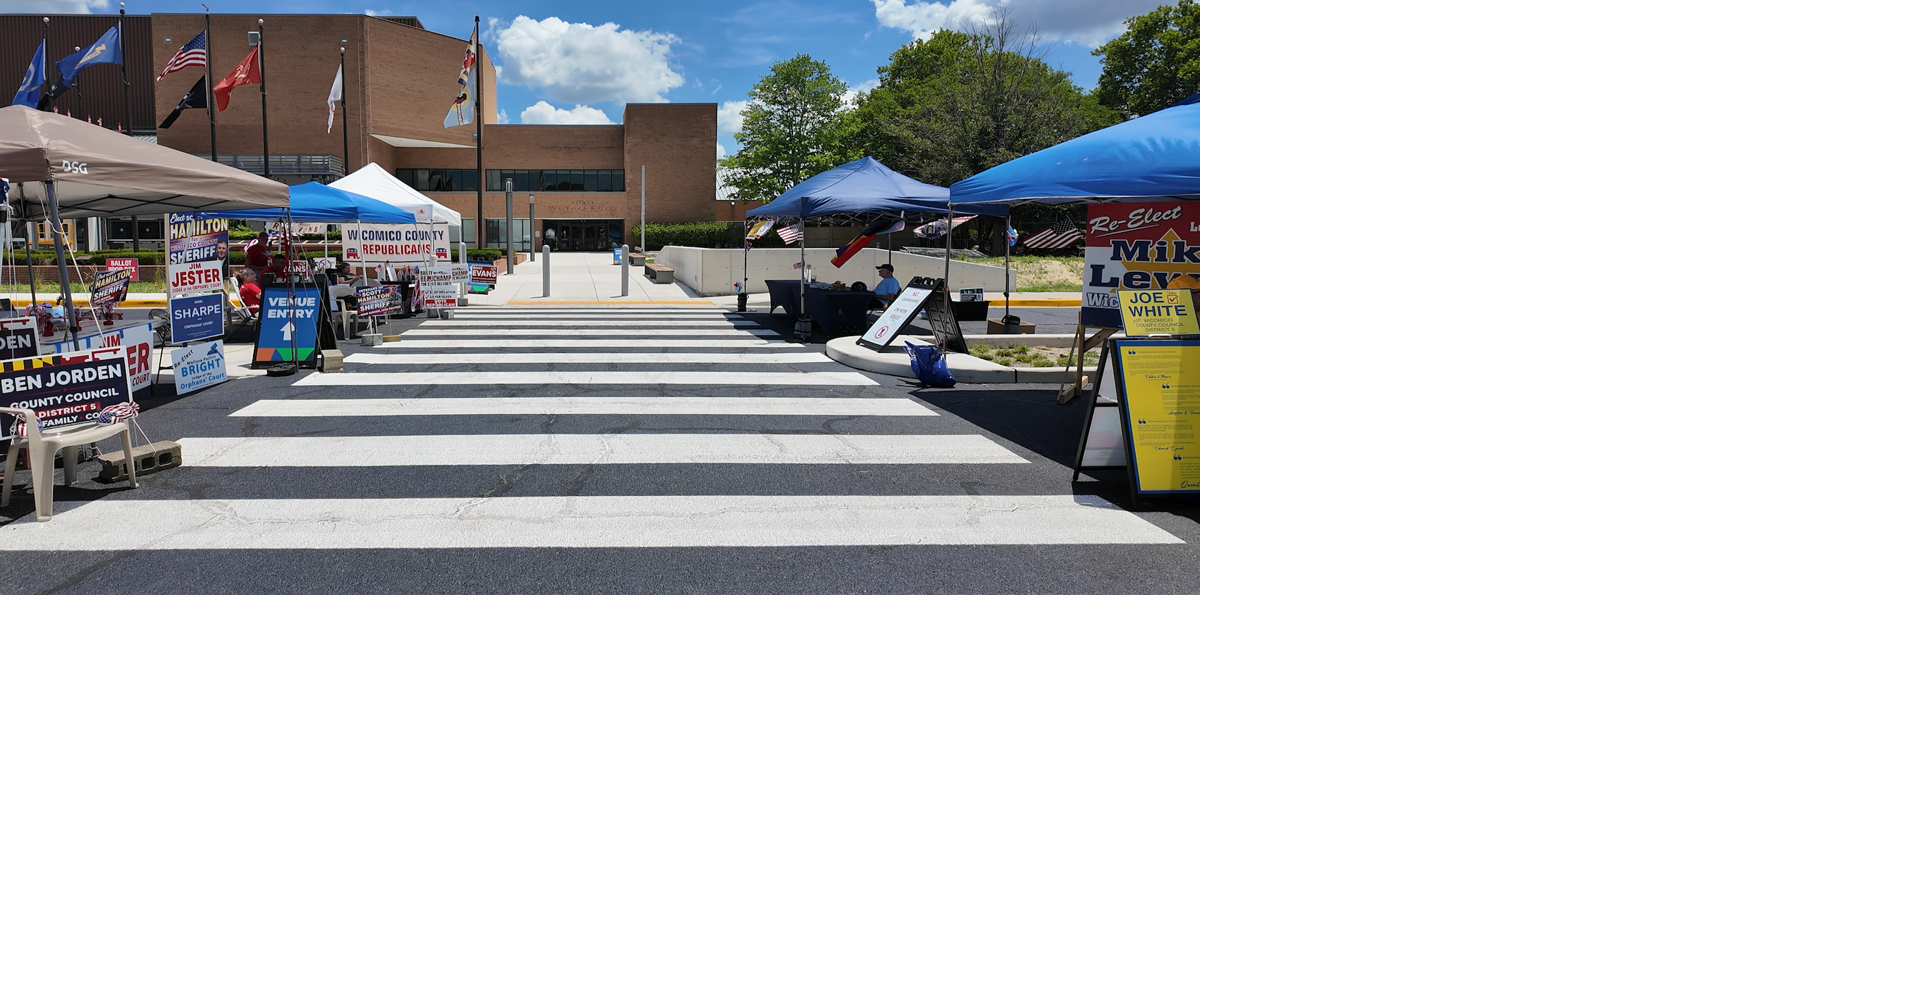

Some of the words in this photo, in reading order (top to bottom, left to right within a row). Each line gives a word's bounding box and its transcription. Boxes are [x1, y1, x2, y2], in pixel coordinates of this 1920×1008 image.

[62, 160, 88, 175] DSG
[1089, 205, 1182, 235] Re-Elect
[170, 218, 228, 240] HAMILTON
[347, 229, 401, 241] WCOMICO
[405, 230, 444, 241] COUNTY
[171, 242, 197, 251] WICOMCO
[362, 243, 431, 255] REPUBLICANS
[170, 245, 216, 265] SHERIFF
[95, 269, 132, 290] HAMILTON
[171, 268, 221, 288] JESTER
[472, 269, 497, 278] EVANS
[94, 282, 125, 301] SHERIFF
[357, 293, 390, 304] HAMILTON
[1129, 292, 1165, 304] JOE
[268, 297, 316, 307] VENUE
[360, 301, 390, 312] SHERIFF
[174, 304, 221, 320] SHARPE
[267, 309, 314, 319] ENTRY
[1128, 305, 1188, 317] WHITE
[181, 358, 221, 377] BRIGHT
[1, 373, 43, 394] BEN
[45, 363, 123, 388] JORDEN
[131, 372, 150, 387] COURT
[208, 372, 225, 382] Court
[9, 395, 63, 409] COUNTY
[64, 387, 120, 403] COUNCIL
[38, 404, 88, 419] DISTRICT
[41, 415, 79, 427] FAMILY
